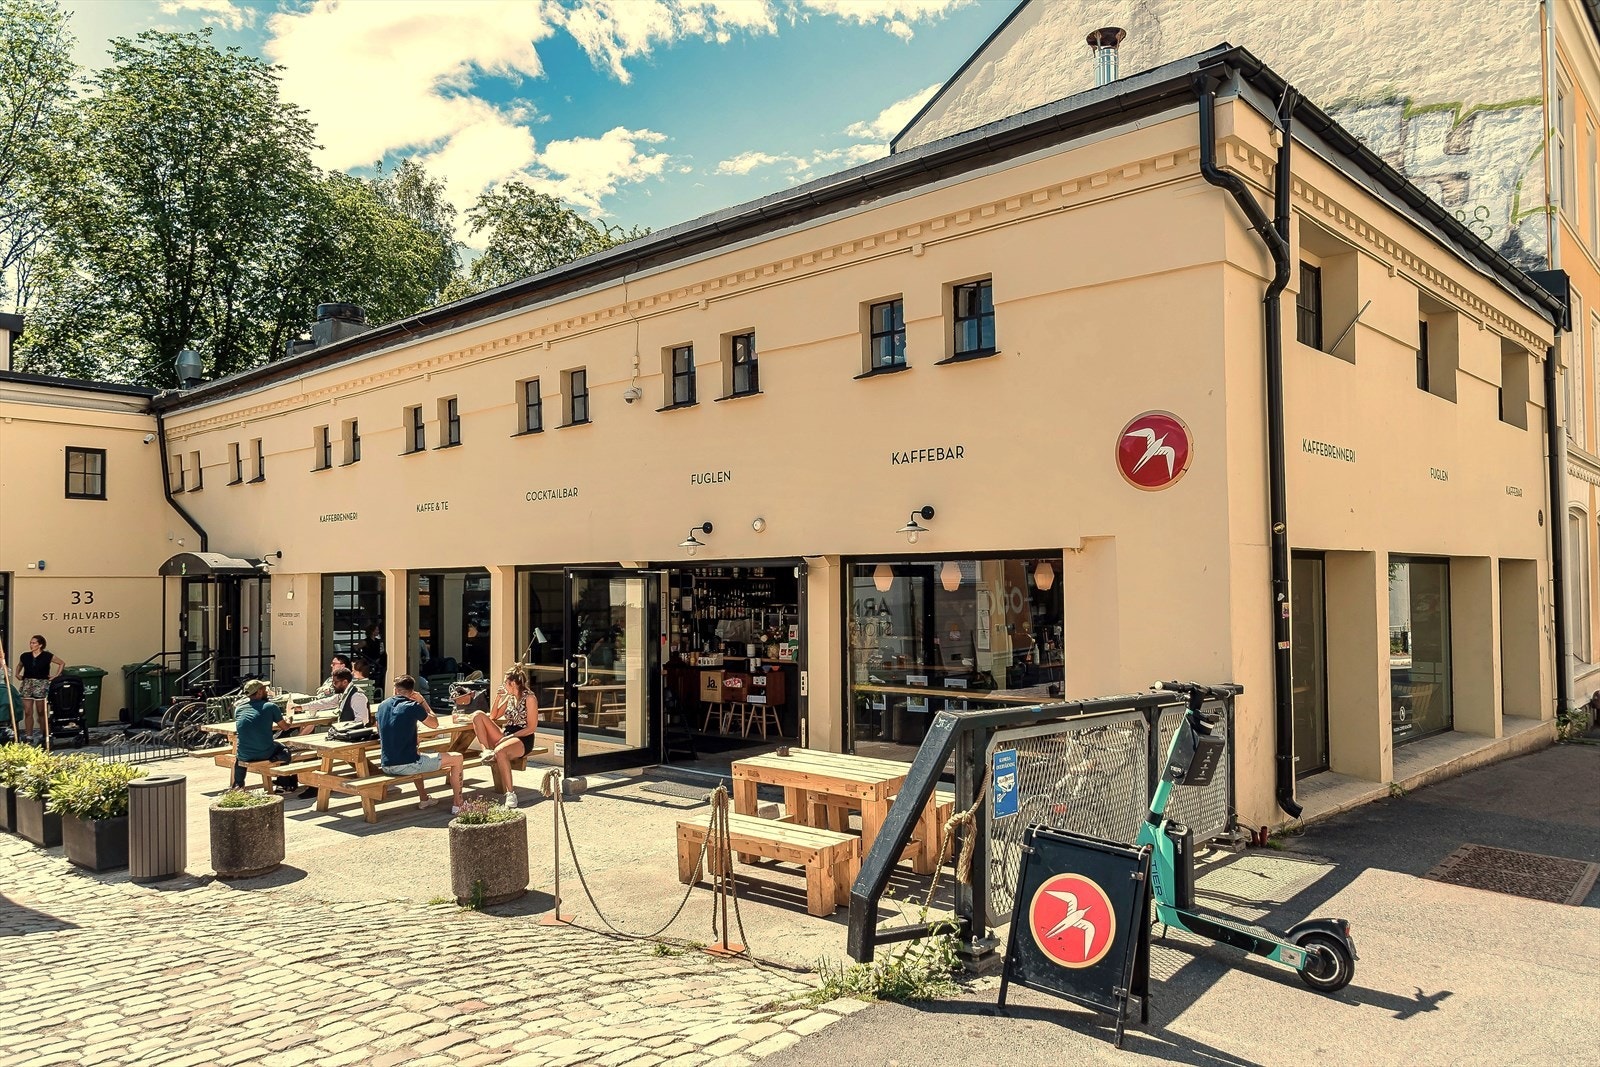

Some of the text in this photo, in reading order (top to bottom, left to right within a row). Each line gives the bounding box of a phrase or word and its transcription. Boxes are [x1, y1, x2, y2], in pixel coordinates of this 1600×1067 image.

[892, 445, 964, 465] KAFFEBAR
[1302, 438, 1356, 463] KAFFEBRENNERI
[691, 470, 731, 485] FUGLEN
[1430, 467, 1449, 481] FUGLEN
[525, 487, 578, 501] COCKTAILBAR
[416, 501, 449, 513] KAFFE & TE
[319, 512, 358, 523] KAFFEBRENNERI
[71, 591, 95, 605] 33
[42, 611, 120, 620] ST. HALVARDS
[68, 626, 96, 634] GATE
[1151, 860, 1163, 897] TIER
